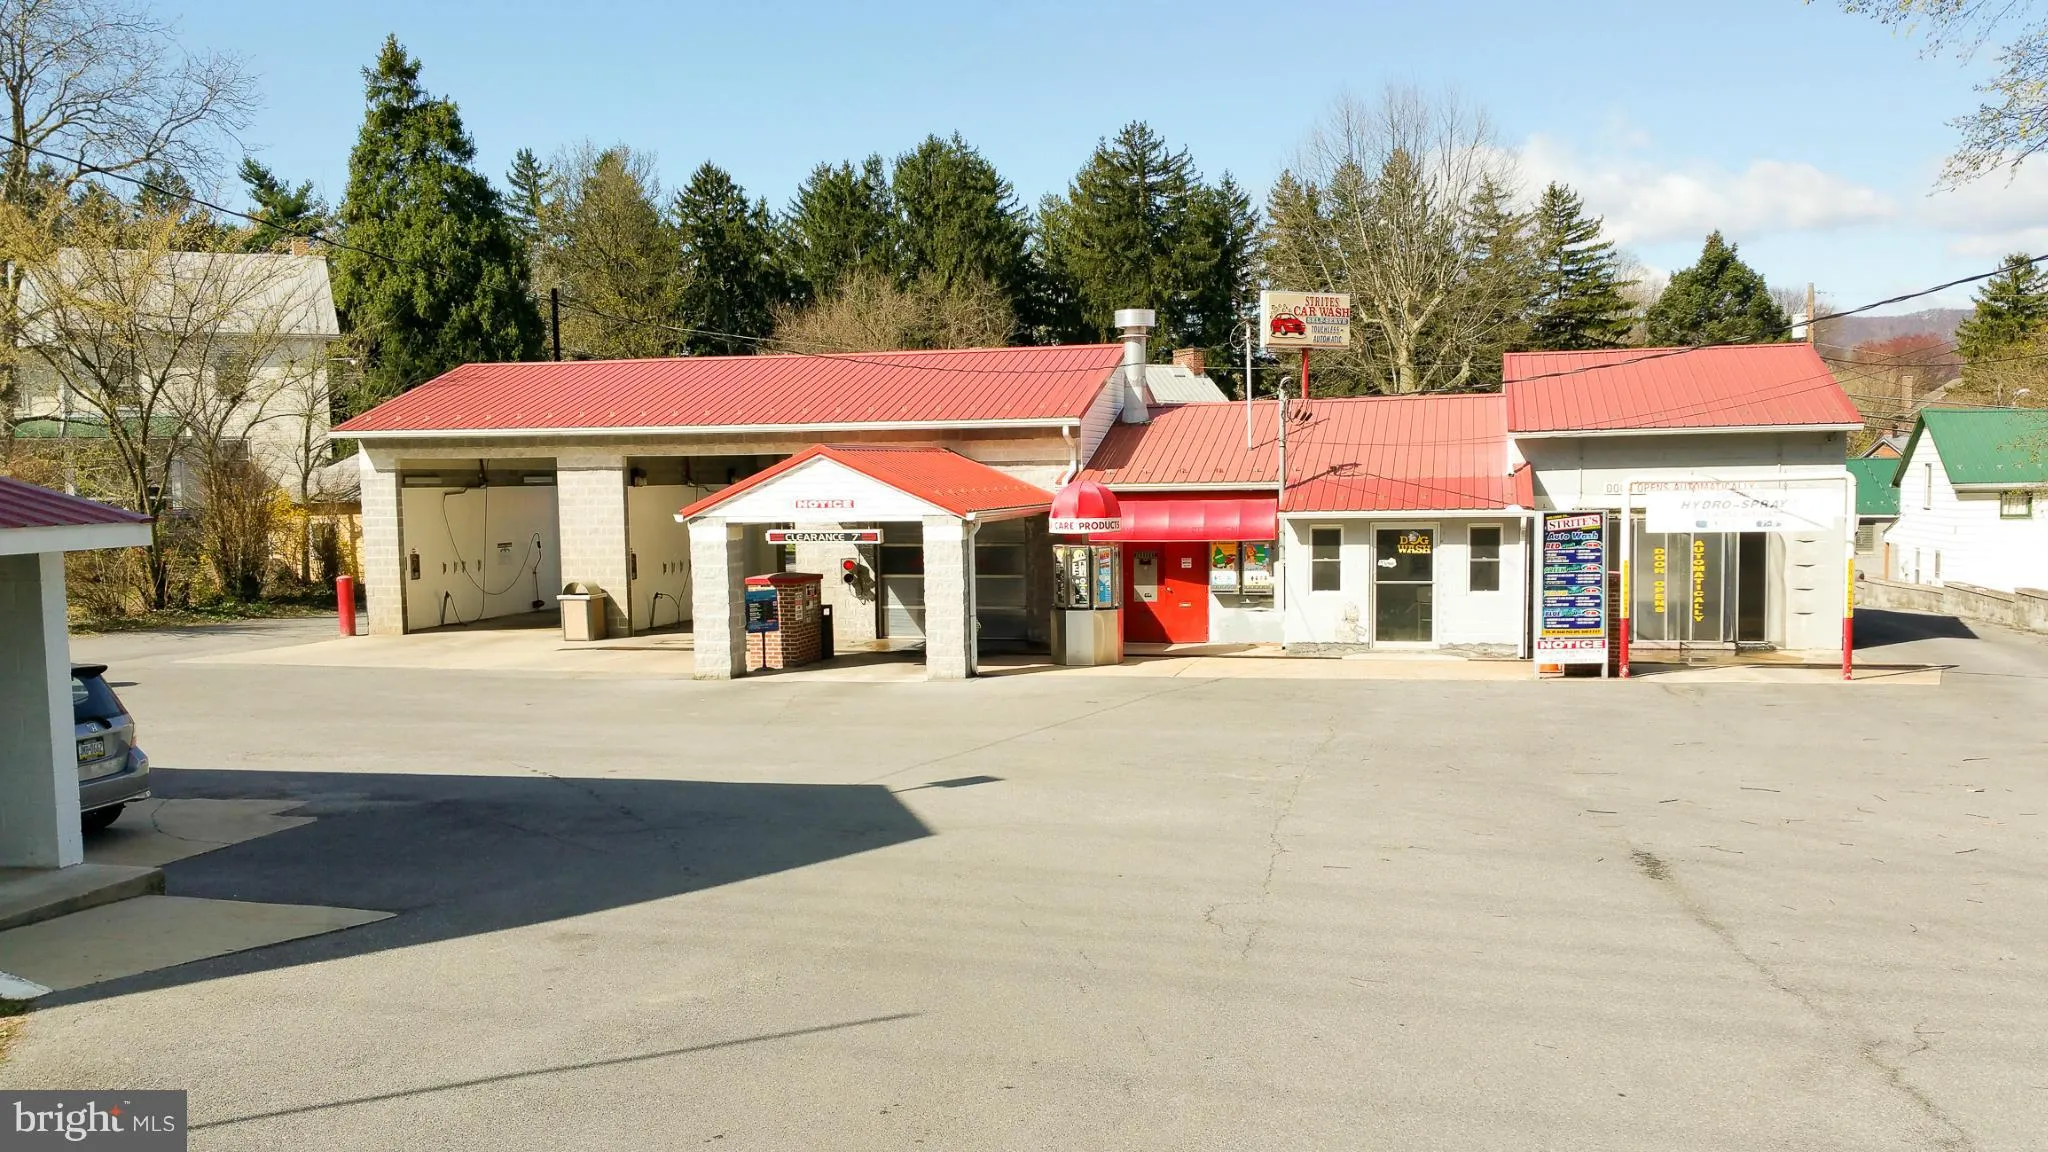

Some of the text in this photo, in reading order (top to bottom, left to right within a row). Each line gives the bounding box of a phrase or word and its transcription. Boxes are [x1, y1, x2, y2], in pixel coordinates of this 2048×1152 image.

[1305, 296, 1341, 307] STRITES
[1293, 305, 1350, 318] CAR WASH
[1312, 335, 1343, 343] AUTOMATIC
[1637, 482, 1669, 492] OPENS
[1673, 481, 1757, 492] AUTOMATICALLY
[797, 500, 853, 508] NOTICE
[1680, 498, 1788, 510] HYDRO-SPRAY
[1055, 520, 1120, 531] CARE PRODUCTS
[1548, 516, 1599, 529] STRITE'S
[785, 533, 845, 542] CLEARANCE
[1399, 534, 1429, 545] DOG
[1547, 531, 1599, 540] Auto Wash
[1397, 545, 1431, 554] WASH
[1653, 547, 1665, 613] DOOR OPENS
[1693, 540, 1705, 622] AUTOMATICALLY
[1539, 640, 1603, 649] NOTICE
